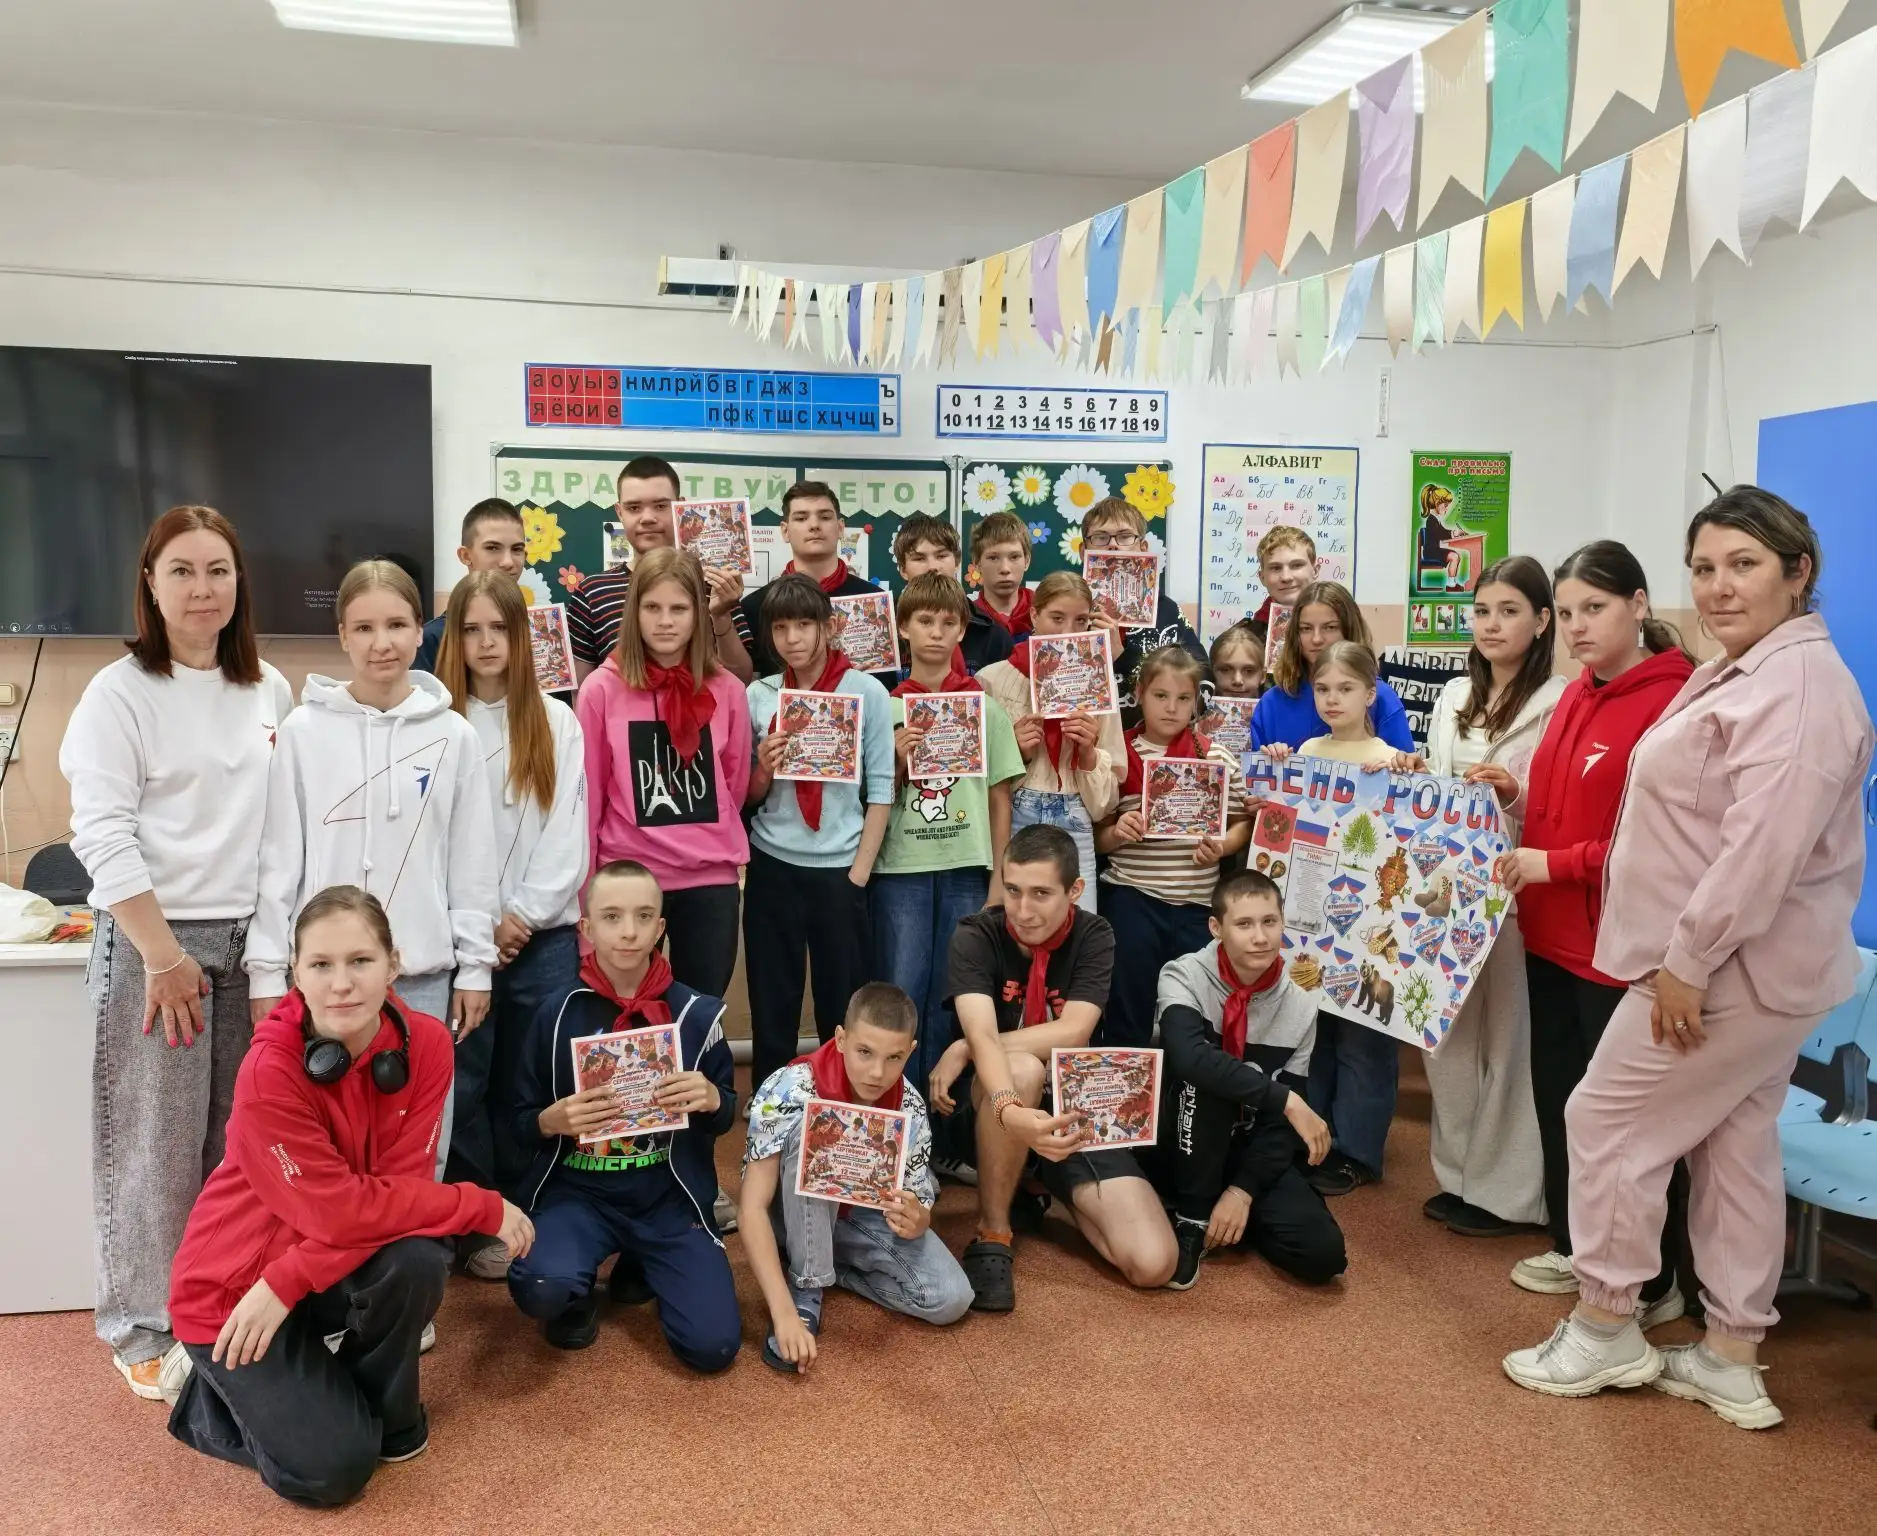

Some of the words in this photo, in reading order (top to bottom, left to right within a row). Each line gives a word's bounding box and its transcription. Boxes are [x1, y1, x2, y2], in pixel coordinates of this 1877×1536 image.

[533, 373, 544, 388] а
[551, 373, 563, 388] о
[568, 374, 580, 394] у
[584, 375, 602, 389] ы
[607, 375, 619, 390] э
[706, 373, 719, 393] б
[725, 378, 737, 393] в
[745, 379, 755, 394] г
[760, 381, 775, 399] д
[777, 381, 794, 395] ж
[798, 381, 809, 396] з
[533, 402, 545, 416] я
[551, 397, 563, 417] ё
[566, 403, 584, 418] ю
[587, 404, 599, 418] и
[607, 404, 619, 419] е
[708, 407, 720, 422] п
[723, 402, 740, 427] ф
[745, 408, 755, 423] к
[763, 409, 774, 424] т
[777, 409, 793, 424] ш
[797, 409, 808, 424] с
[951, 393, 962, 408] 0
[974, 394, 982, 408] 1
[994, 394, 1005, 410] 2
[1018, 395, 1028, 409] 3
[1039, 396, 1050, 411] 4
[1063, 397, 1073, 411] 5
[1086, 397, 1096, 412] 6
[1108, 398, 1118, 412] 7
[1128, 399, 1139, 413] 8
[1149, 399, 1159, 412] 9
[944, 413, 962, 428] 10
[965, 414, 983, 428] 11
[987, 414, 1005, 430] 12
[1010, 415, 1028, 429] 13
[1032, 416, 1051, 430] 14
[1056, 416, 1074, 430] 15
[1078, 417, 1097, 432] 16
[1100, 417, 1117, 431] 17
[1121, 418, 1140, 432] 18
[1142, 418, 1160, 432] 19
[1241, 454, 1323, 469] АЛФАВИТ
[1419, 456, 1447, 467] Сиди
[1450, 459, 1506, 469] правильно
[1447, 467, 1467, 476] при
[503, 469, 787, 499] ЗДРАТВУЙ
[1245, 753, 1356, 805] ДЕНЬ
